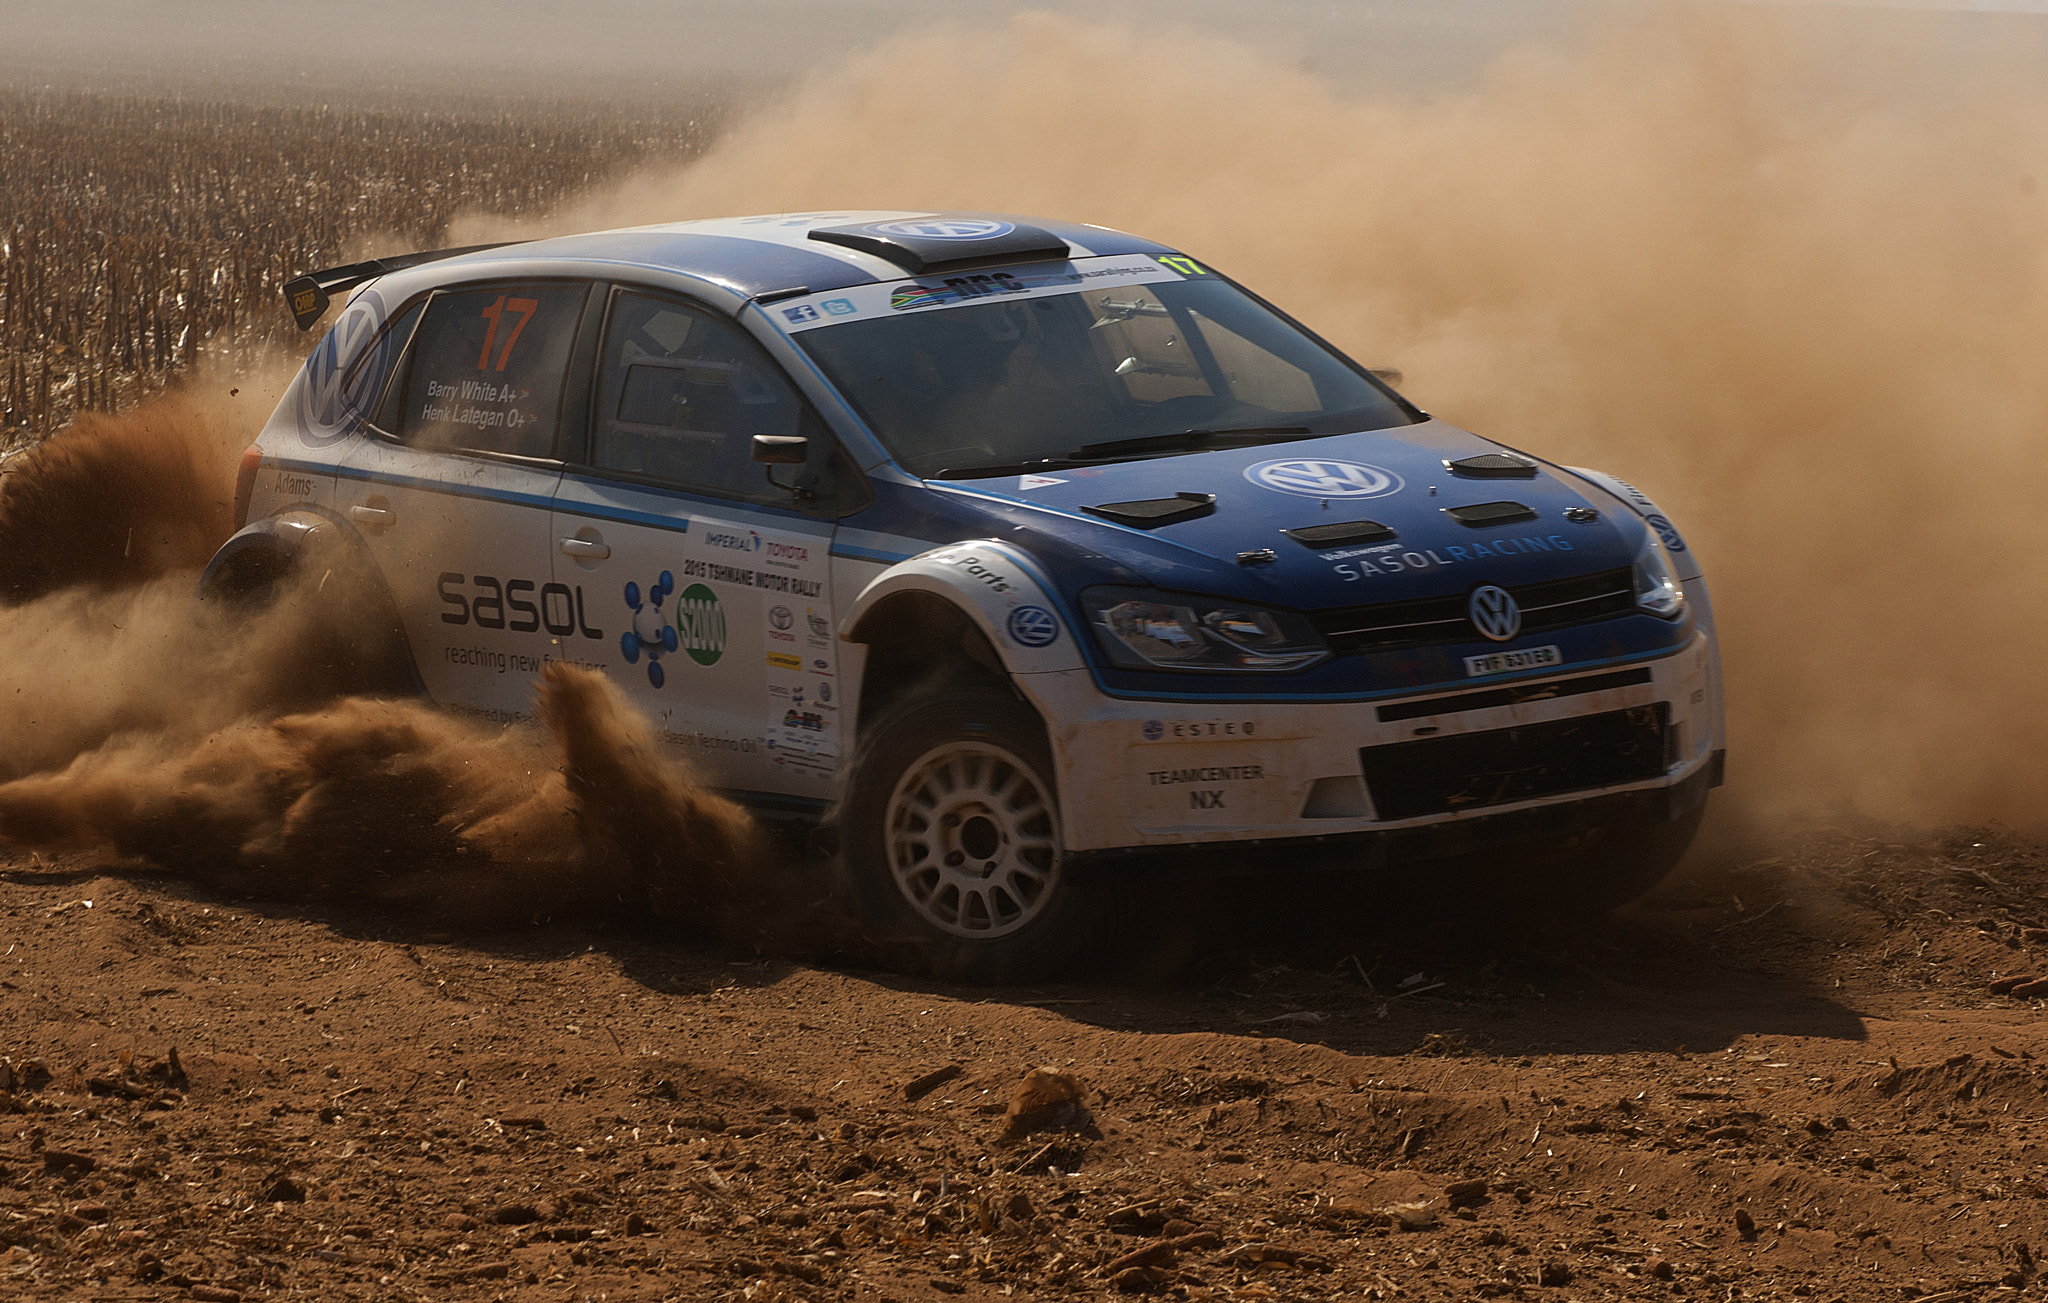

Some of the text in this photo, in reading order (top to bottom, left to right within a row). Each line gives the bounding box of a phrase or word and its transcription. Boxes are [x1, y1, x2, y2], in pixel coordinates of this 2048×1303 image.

[1157, 256, 1206, 275] 17
[294, 292, 316, 312] OMP
[477, 295, 538, 372] 17
[427, 381, 517, 403] Barry White A+
[422, 404, 526, 430] Henk Lategan O+
[274, 472, 312, 496] Adams
[705, 532, 752, 552] IMPERIAL
[766, 542, 809, 562] TOYOTA
[1318, 543, 1404, 562] Volkswagen
[683, 559, 706, 578] 2015
[708, 563, 754, 586] TSHWANE
[755, 571, 790, 593] MOTOR
[791, 577, 822, 598] RALLY
[956, 556, 1012, 593] Parts
[679, 596, 724, 652] S2000
[445, 646, 506, 674] reaching
[510, 654, 540, 673] new
[1147, 765, 1265, 786] TEAMCENTER
[1189, 790, 1225, 810] NX
